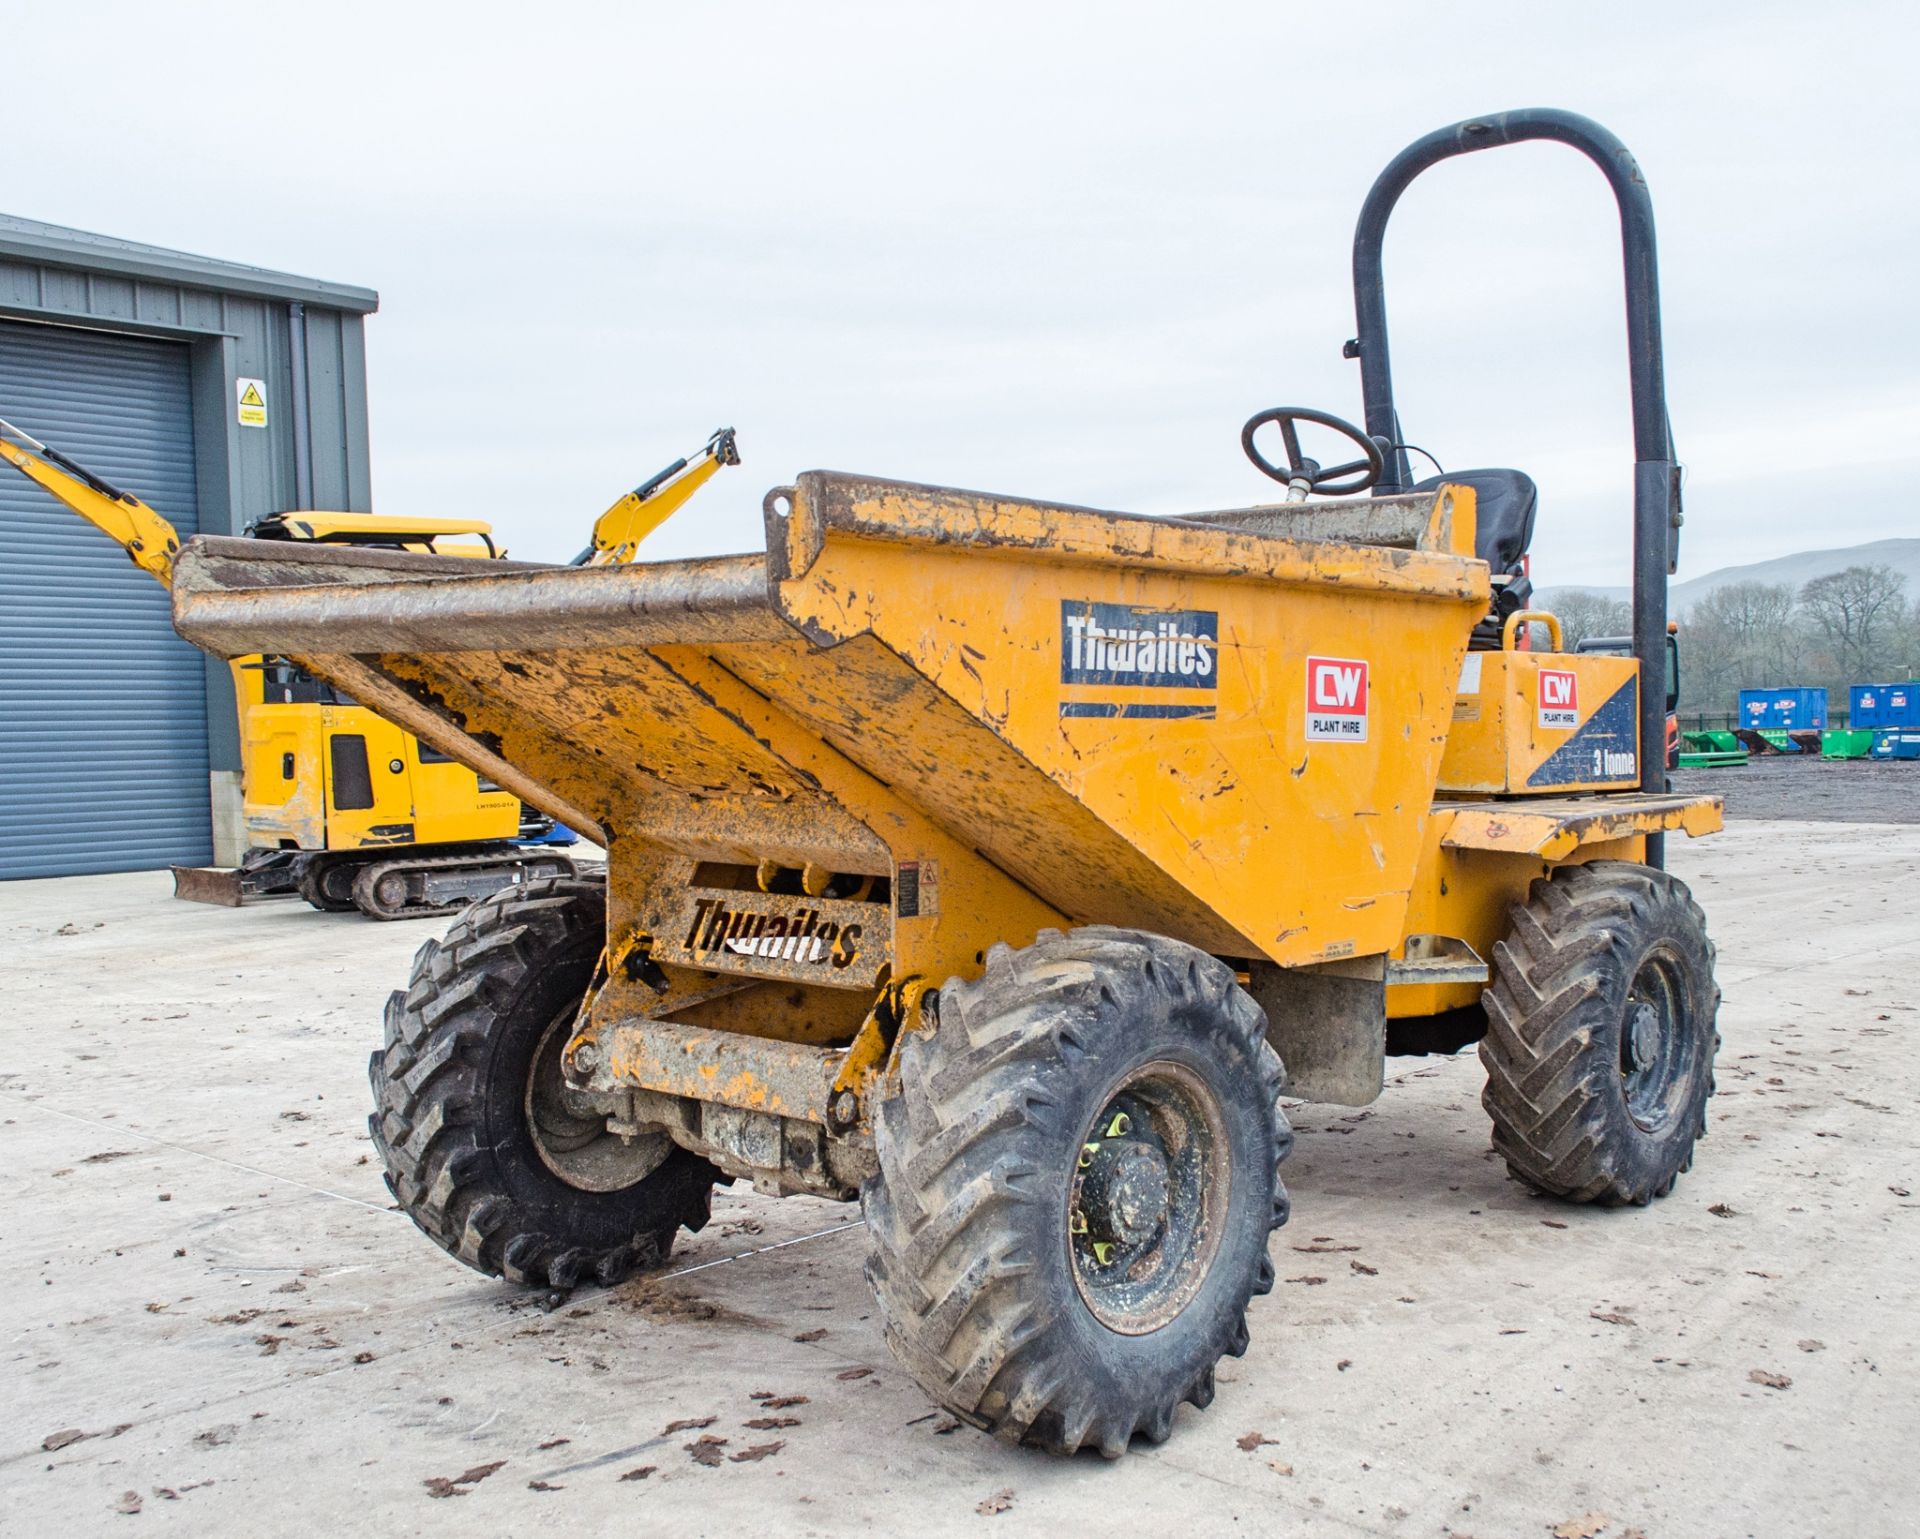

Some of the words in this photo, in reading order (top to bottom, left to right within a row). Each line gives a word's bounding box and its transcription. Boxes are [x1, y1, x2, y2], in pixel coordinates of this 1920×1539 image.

[1067, 615, 1212, 676] Thwaites
[1316, 665, 1362, 708] CW
[1544, 675, 1572, 705] CW
[1313, 719, 1340, 733] PLANT
[1342, 721, 1360, 734] HIRE
[1544, 713, 1561, 722] PLANT
[1564, 714, 1575, 723] HIRE
[1593, 749, 1602, 776] 3
[684, 898, 863, 969] Thwaites
